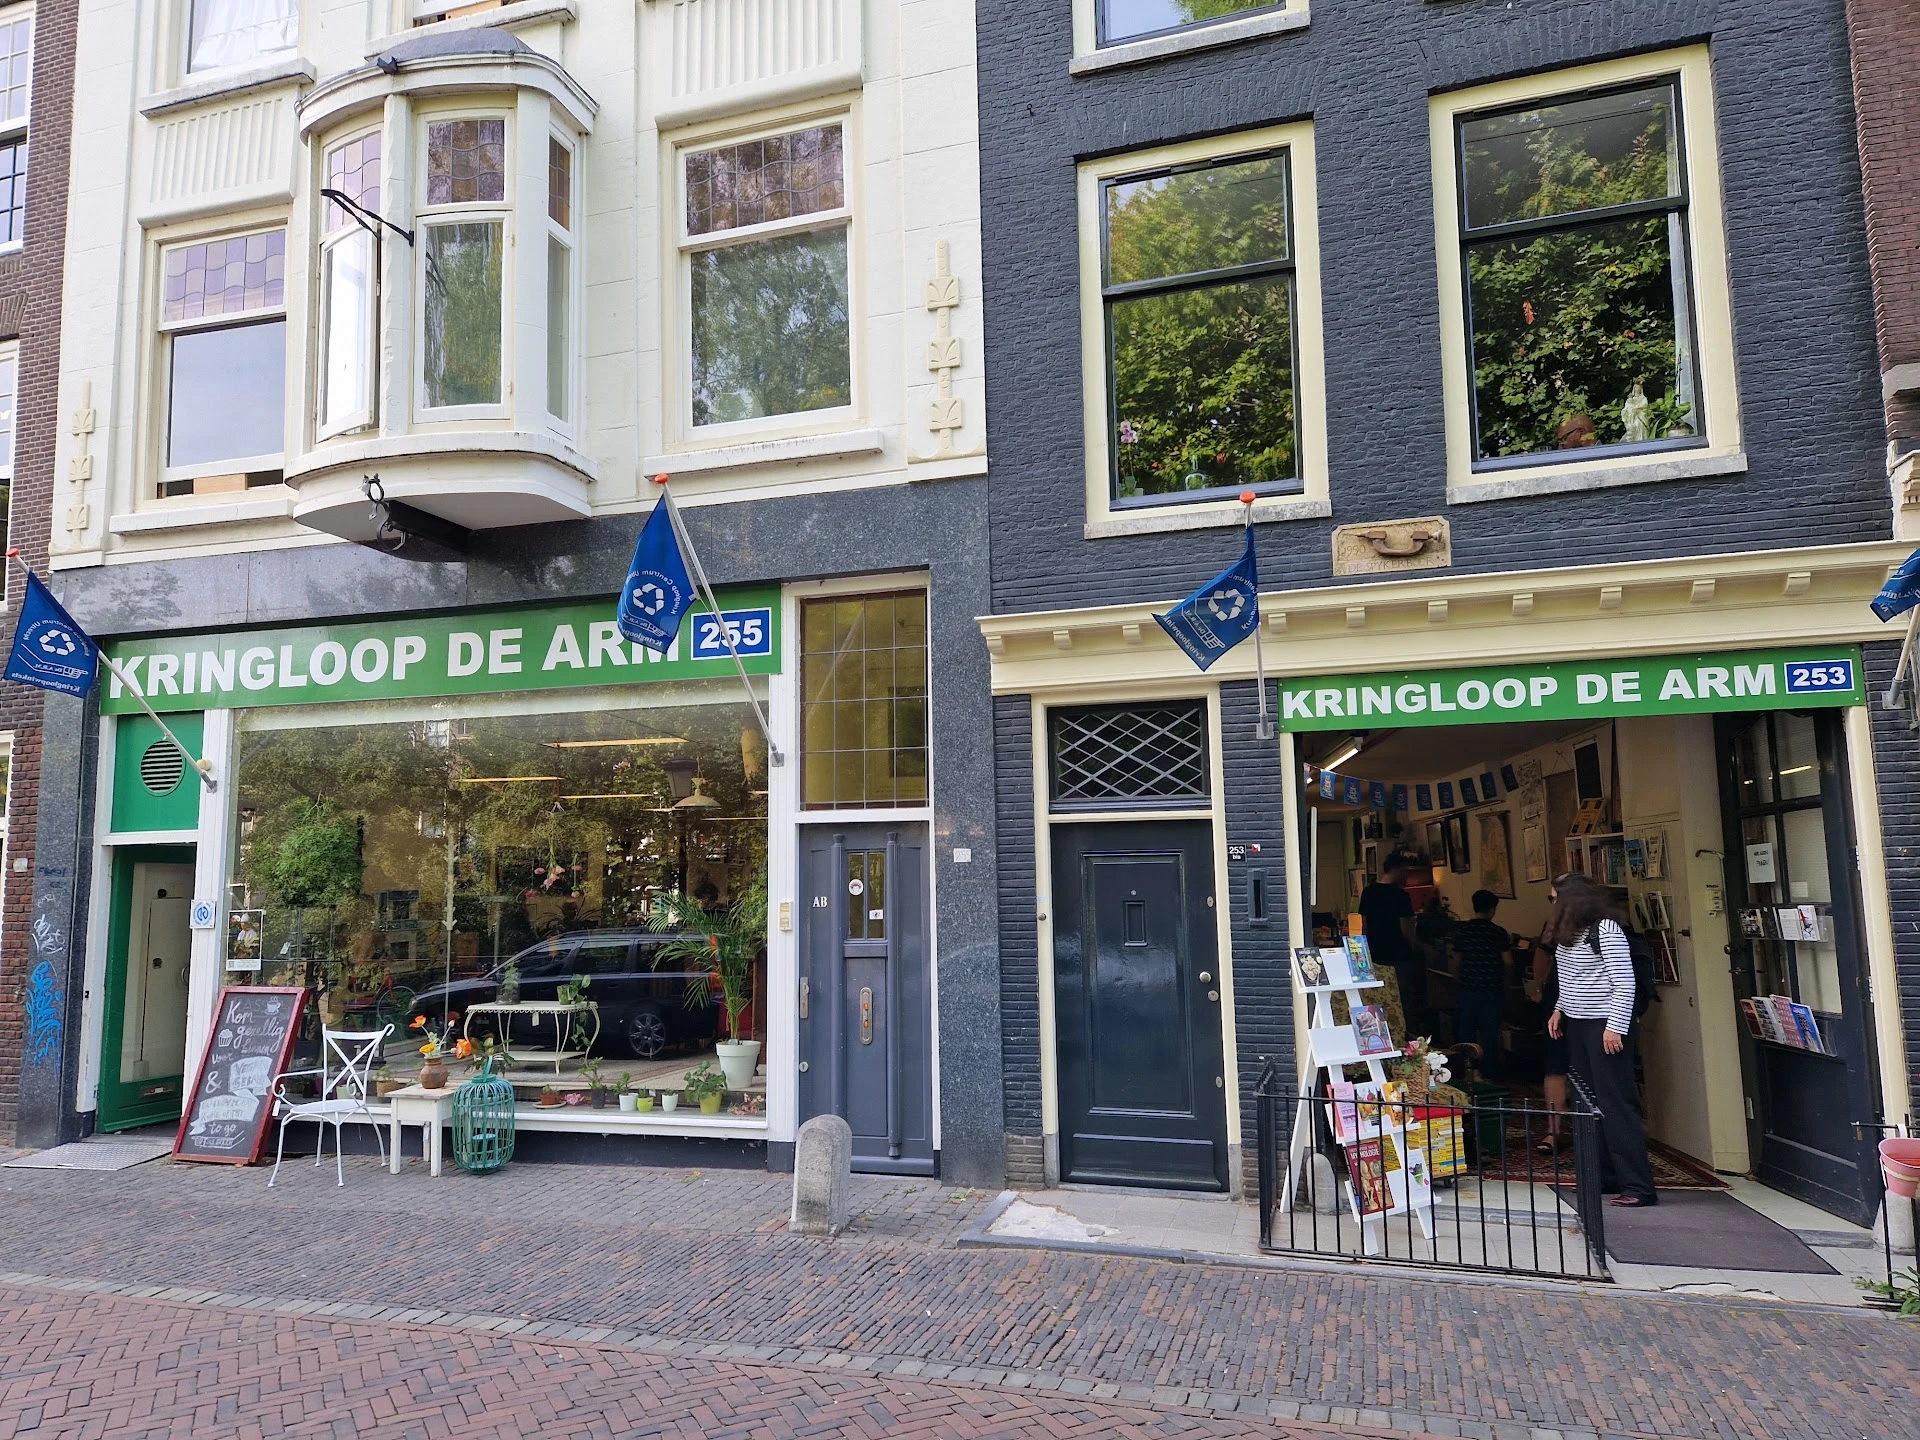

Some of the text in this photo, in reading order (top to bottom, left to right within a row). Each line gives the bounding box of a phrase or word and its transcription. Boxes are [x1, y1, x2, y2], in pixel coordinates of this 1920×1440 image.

[699, 617, 763, 650] 255
[110, 635, 427, 699] KRINGLOOP
[447, 627, 523, 677] DE
[1792, 666, 1847, 687] 253
[1282, 663, 1776, 719] KRINGLOOP DE ARM
[1228, 845, 1245, 855] 253
[812, 896, 828, 908] AB
[205, 1071, 222, 1094] &
[208, 1121, 237, 1137] to go
[1350, 1148, 1381, 1160] MYHOLOGIE
